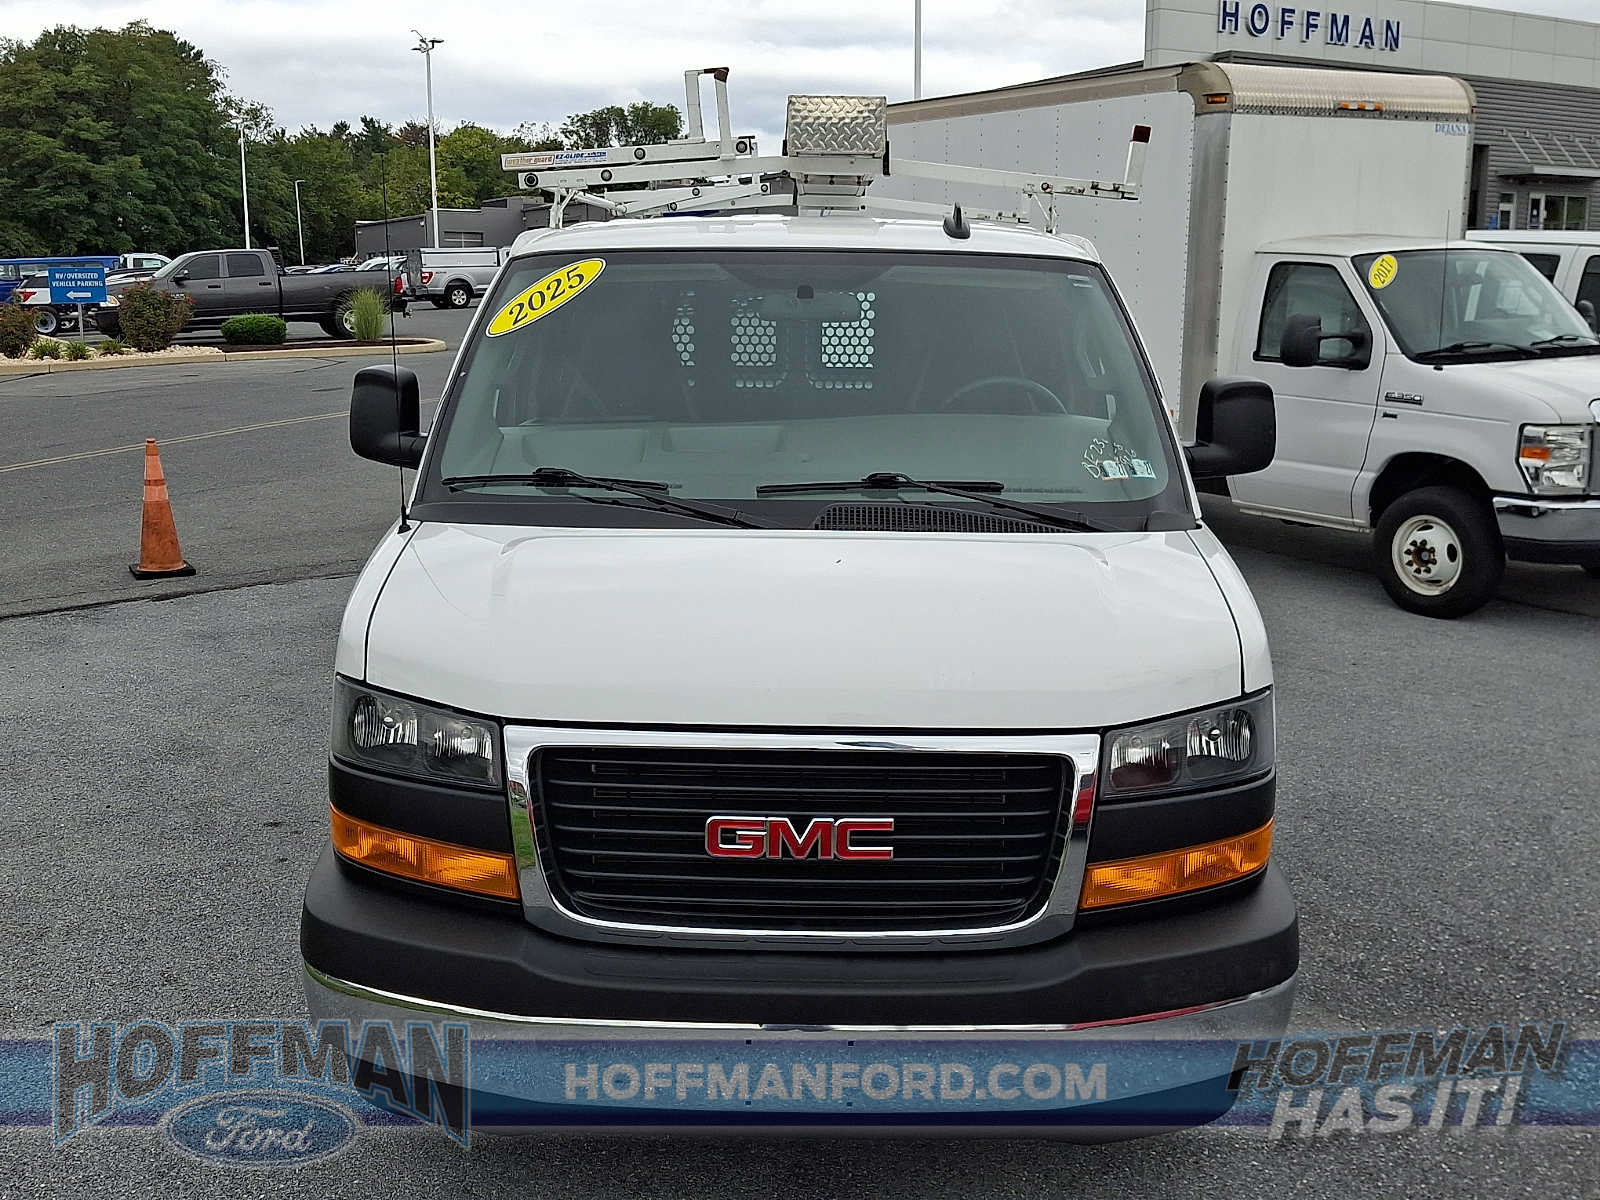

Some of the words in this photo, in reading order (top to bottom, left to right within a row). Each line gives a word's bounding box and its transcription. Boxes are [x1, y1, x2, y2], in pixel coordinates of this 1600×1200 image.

[1220, 0, 1401, 50] HOFFMAN
[1373, 258, 1393, 284] 2017
[508, 265, 585, 326] 2025
[704, 815, 895, 860] GMC
